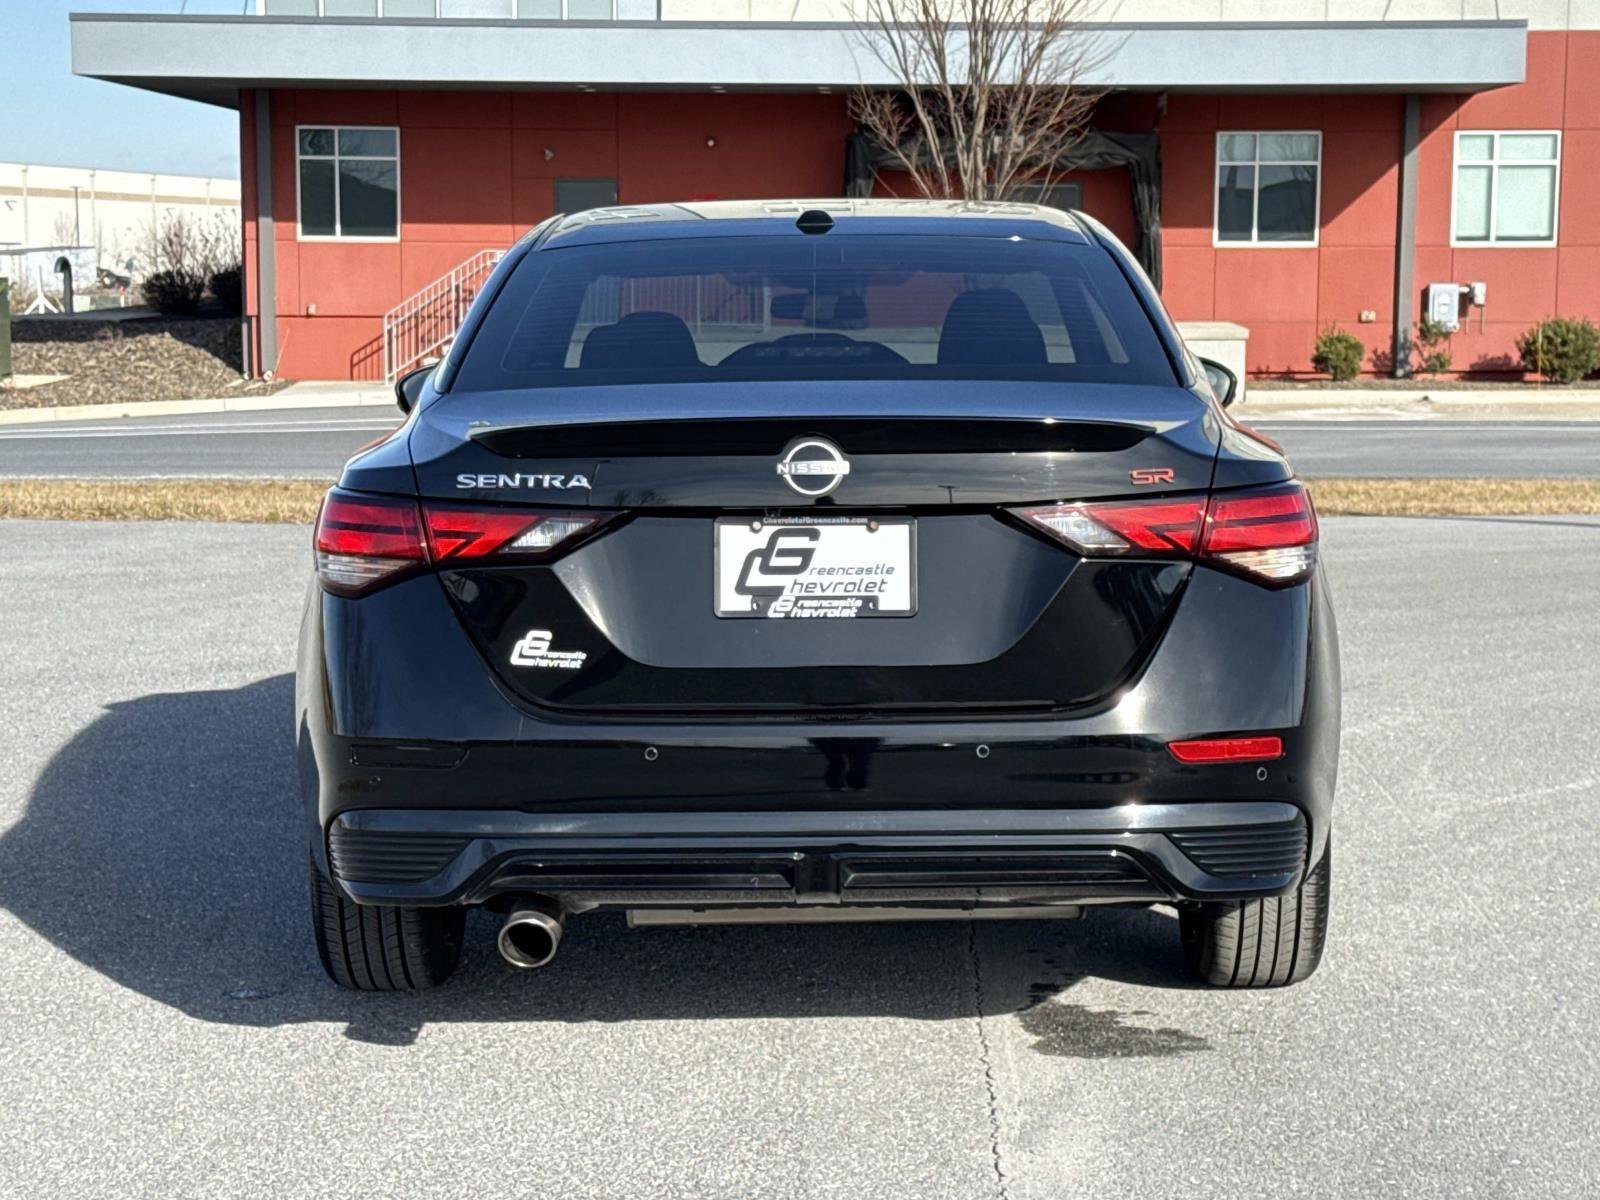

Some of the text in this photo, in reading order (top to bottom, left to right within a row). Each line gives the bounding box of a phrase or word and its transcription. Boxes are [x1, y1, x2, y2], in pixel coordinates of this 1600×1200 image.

[776, 462, 850, 475] NISSA
[1129, 468, 1175, 485] SR
[456, 473, 592, 490] SENTRA
